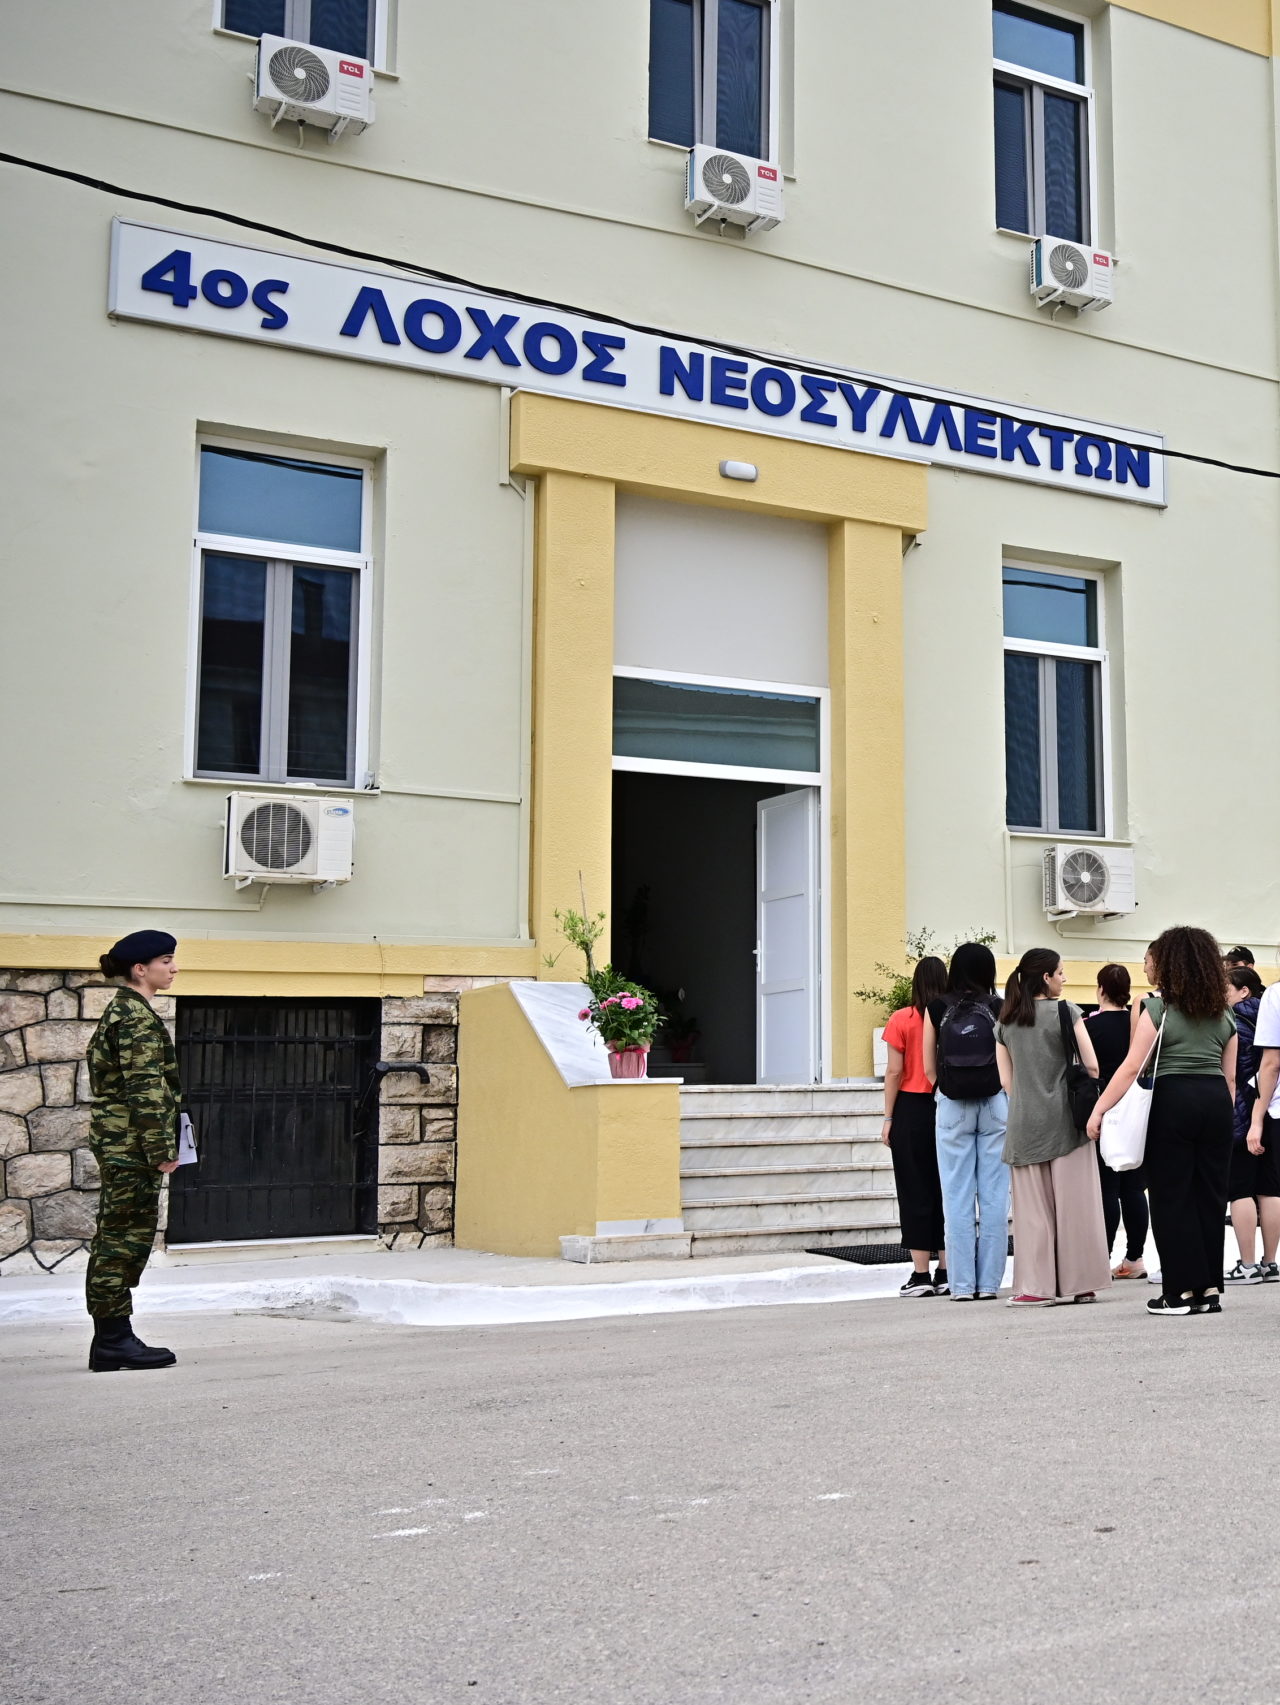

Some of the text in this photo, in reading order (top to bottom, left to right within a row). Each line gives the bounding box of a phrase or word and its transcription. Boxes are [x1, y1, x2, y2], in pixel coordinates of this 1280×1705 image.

[342, 64, 361, 74] TCL
[760, 169, 775, 178] TCL
[1095, 256, 1108, 264] TCL
[141, 250, 1151, 488] 4ος ΛΟΧΟΣ ΝΕΟΣΥΛΛΕΚΤΩΝ
